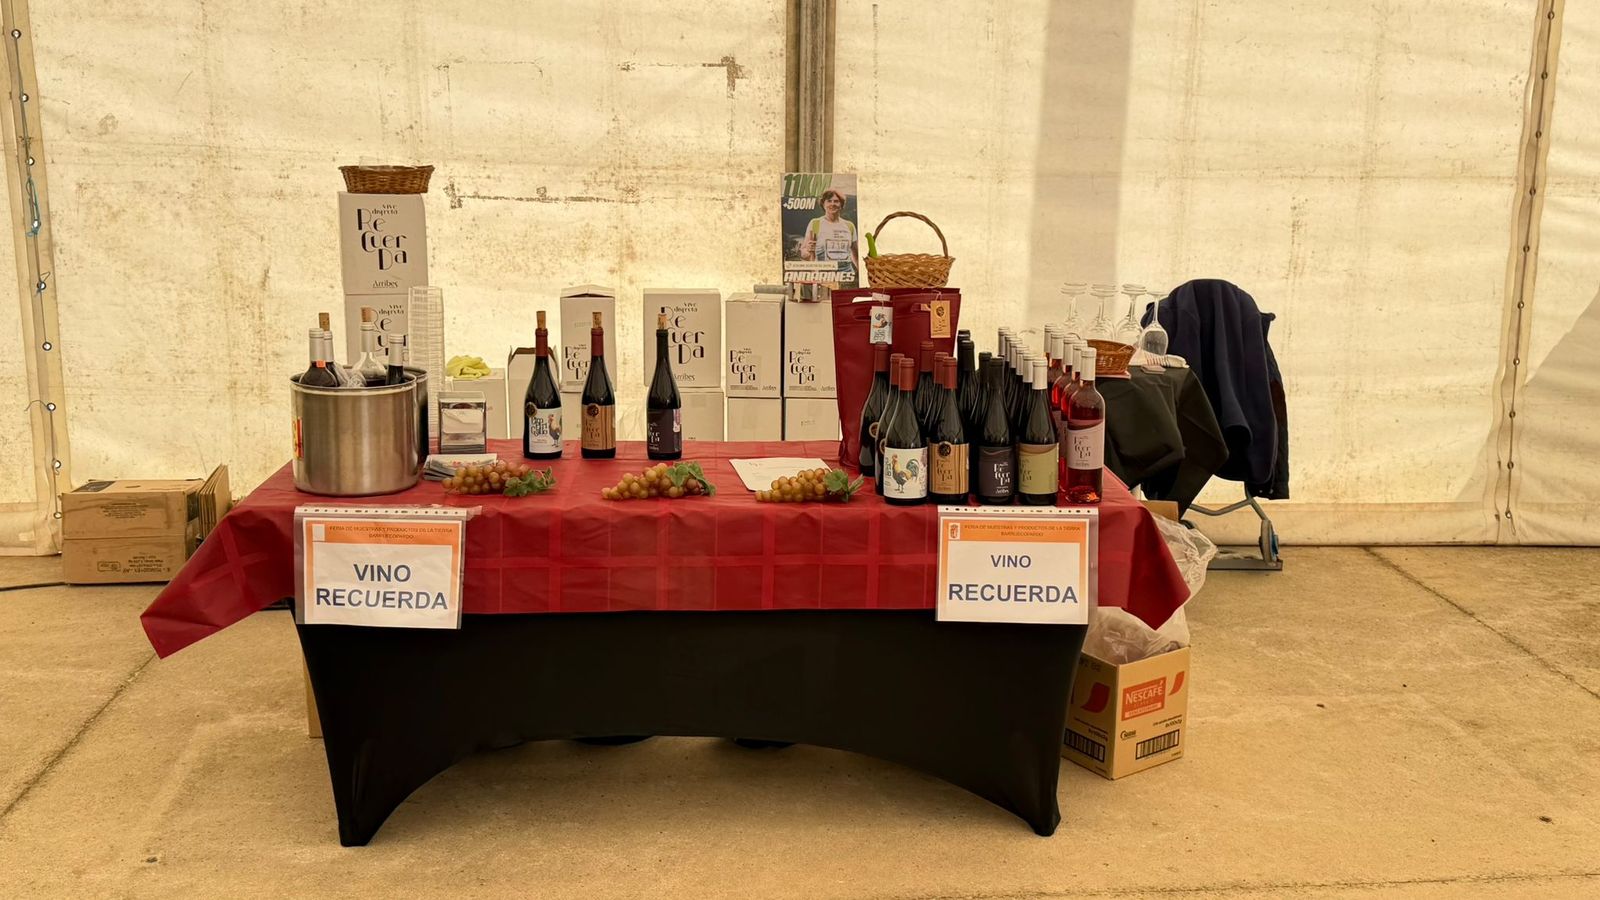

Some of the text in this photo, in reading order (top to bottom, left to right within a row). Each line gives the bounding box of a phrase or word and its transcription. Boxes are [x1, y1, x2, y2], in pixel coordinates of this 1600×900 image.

[783, 198, 816, 210] +500M
[784, 271, 855, 282] ANDARINES
[990, 555, 1031, 568] VINO
[353, 564, 411, 582] VINO
[316, 588, 448, 610] RECUERDA
[949, 583, 1078, 604] RECUERDA
[1125, 680, 1164, 705] NESCAFÉ
